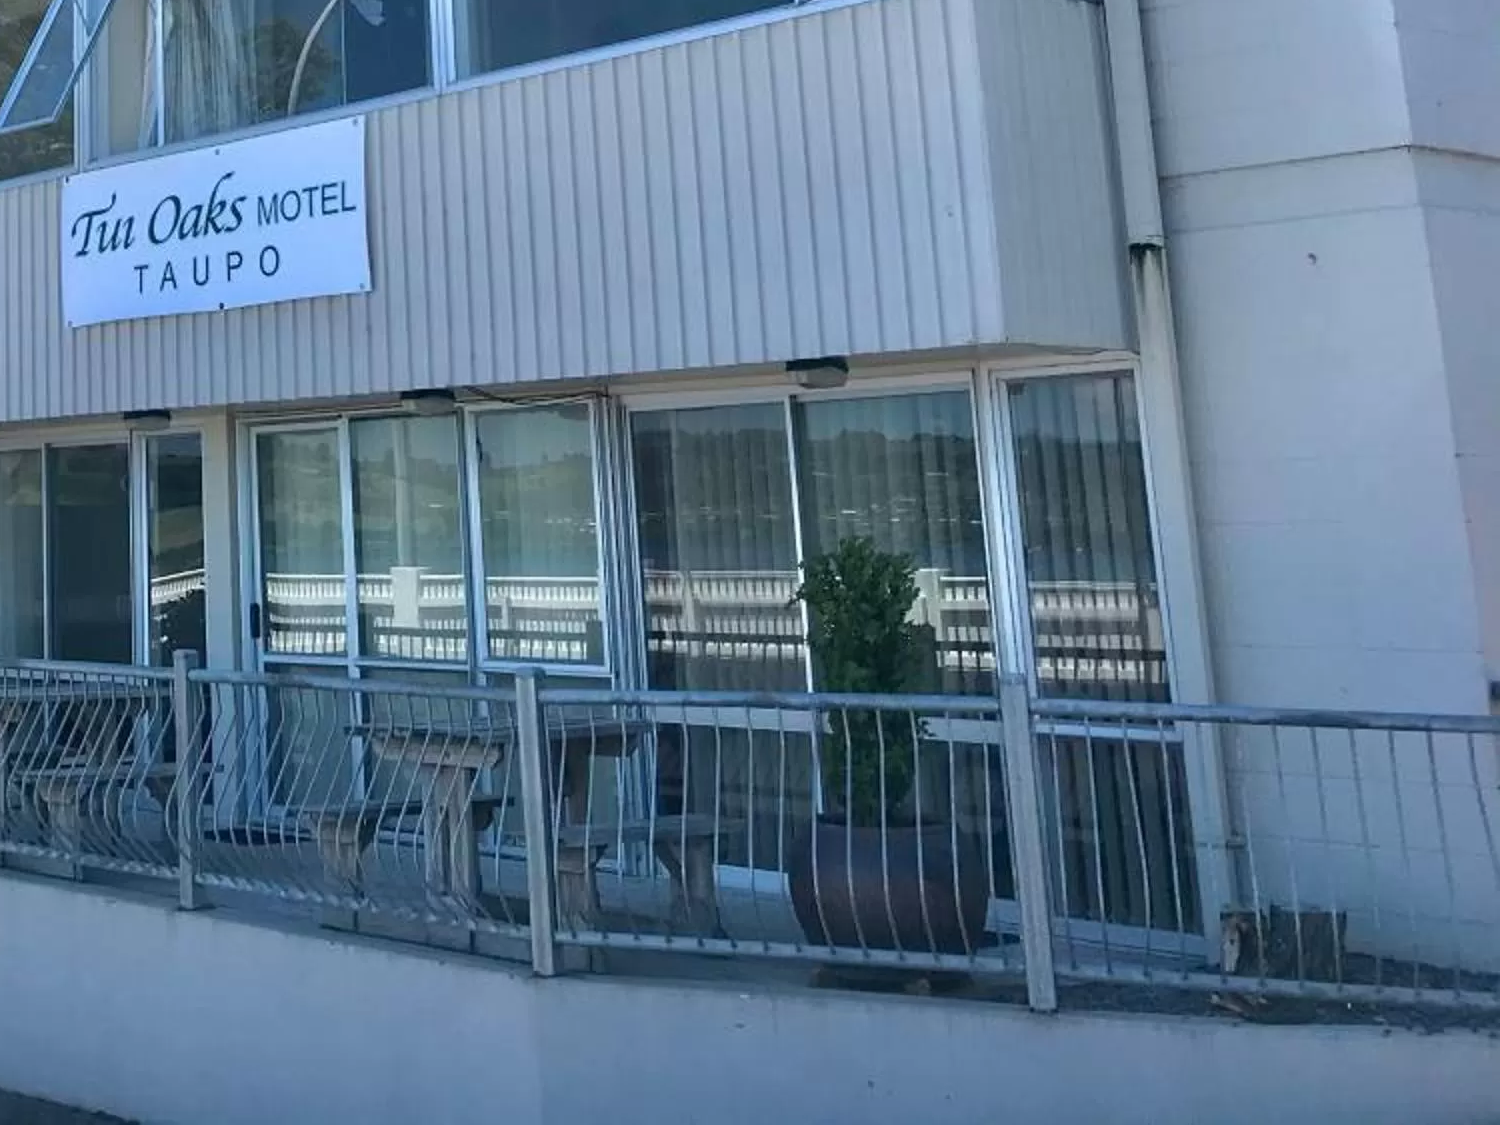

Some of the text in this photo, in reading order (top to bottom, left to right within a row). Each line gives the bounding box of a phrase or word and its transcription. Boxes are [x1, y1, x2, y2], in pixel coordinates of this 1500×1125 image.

[71, 171, 357, 257] Tui Oaks MOTEL
[133, 246, 280, 294] TAUPO
